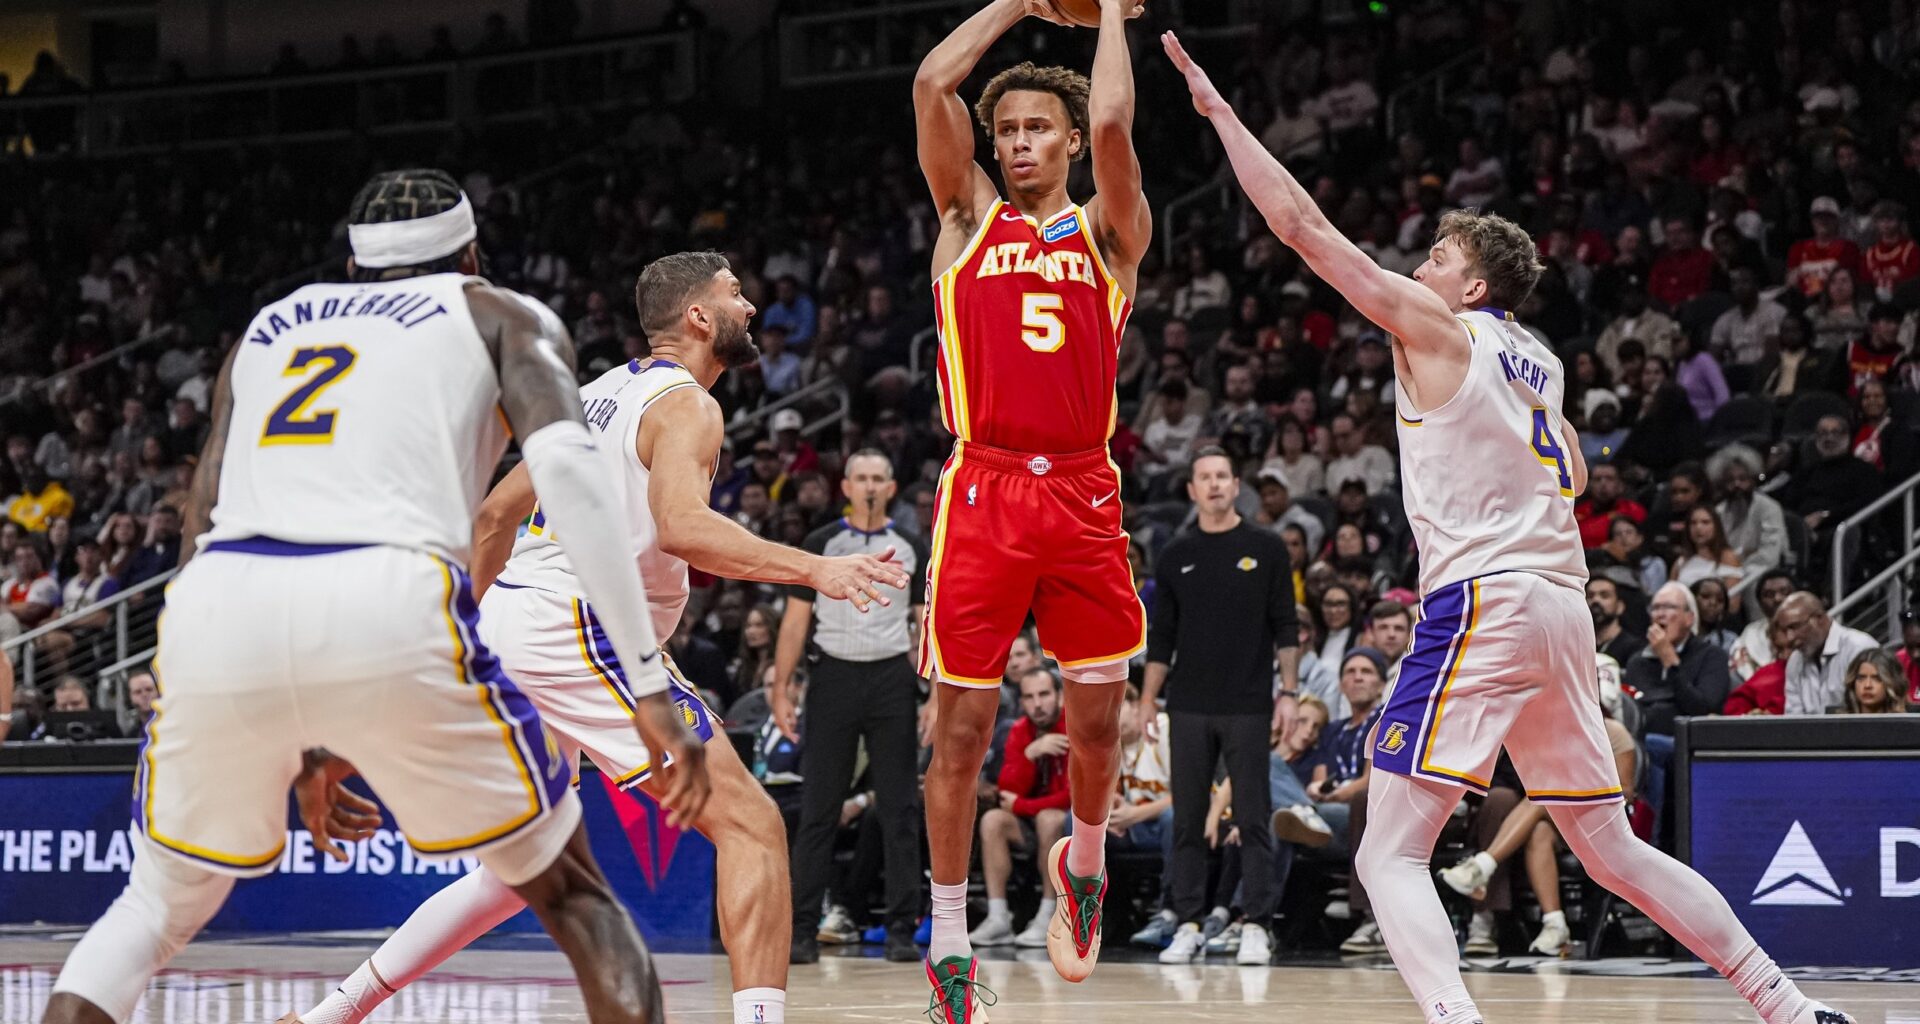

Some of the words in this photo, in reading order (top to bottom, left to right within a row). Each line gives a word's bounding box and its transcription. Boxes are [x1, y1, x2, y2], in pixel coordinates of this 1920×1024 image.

[976, 242, 1097, 290] ATLANTA
[249, 293, 448, 346] VANDERBILT
[1021, 292, 1066, 353] 5
[258, 341, 360, 448] 2
[582, 398, 618, 432] LEBER
[1529, 406, 1575, 498] 4
[0, 830, 54, 872] HE
[59, 830, 134, 872] PLA
